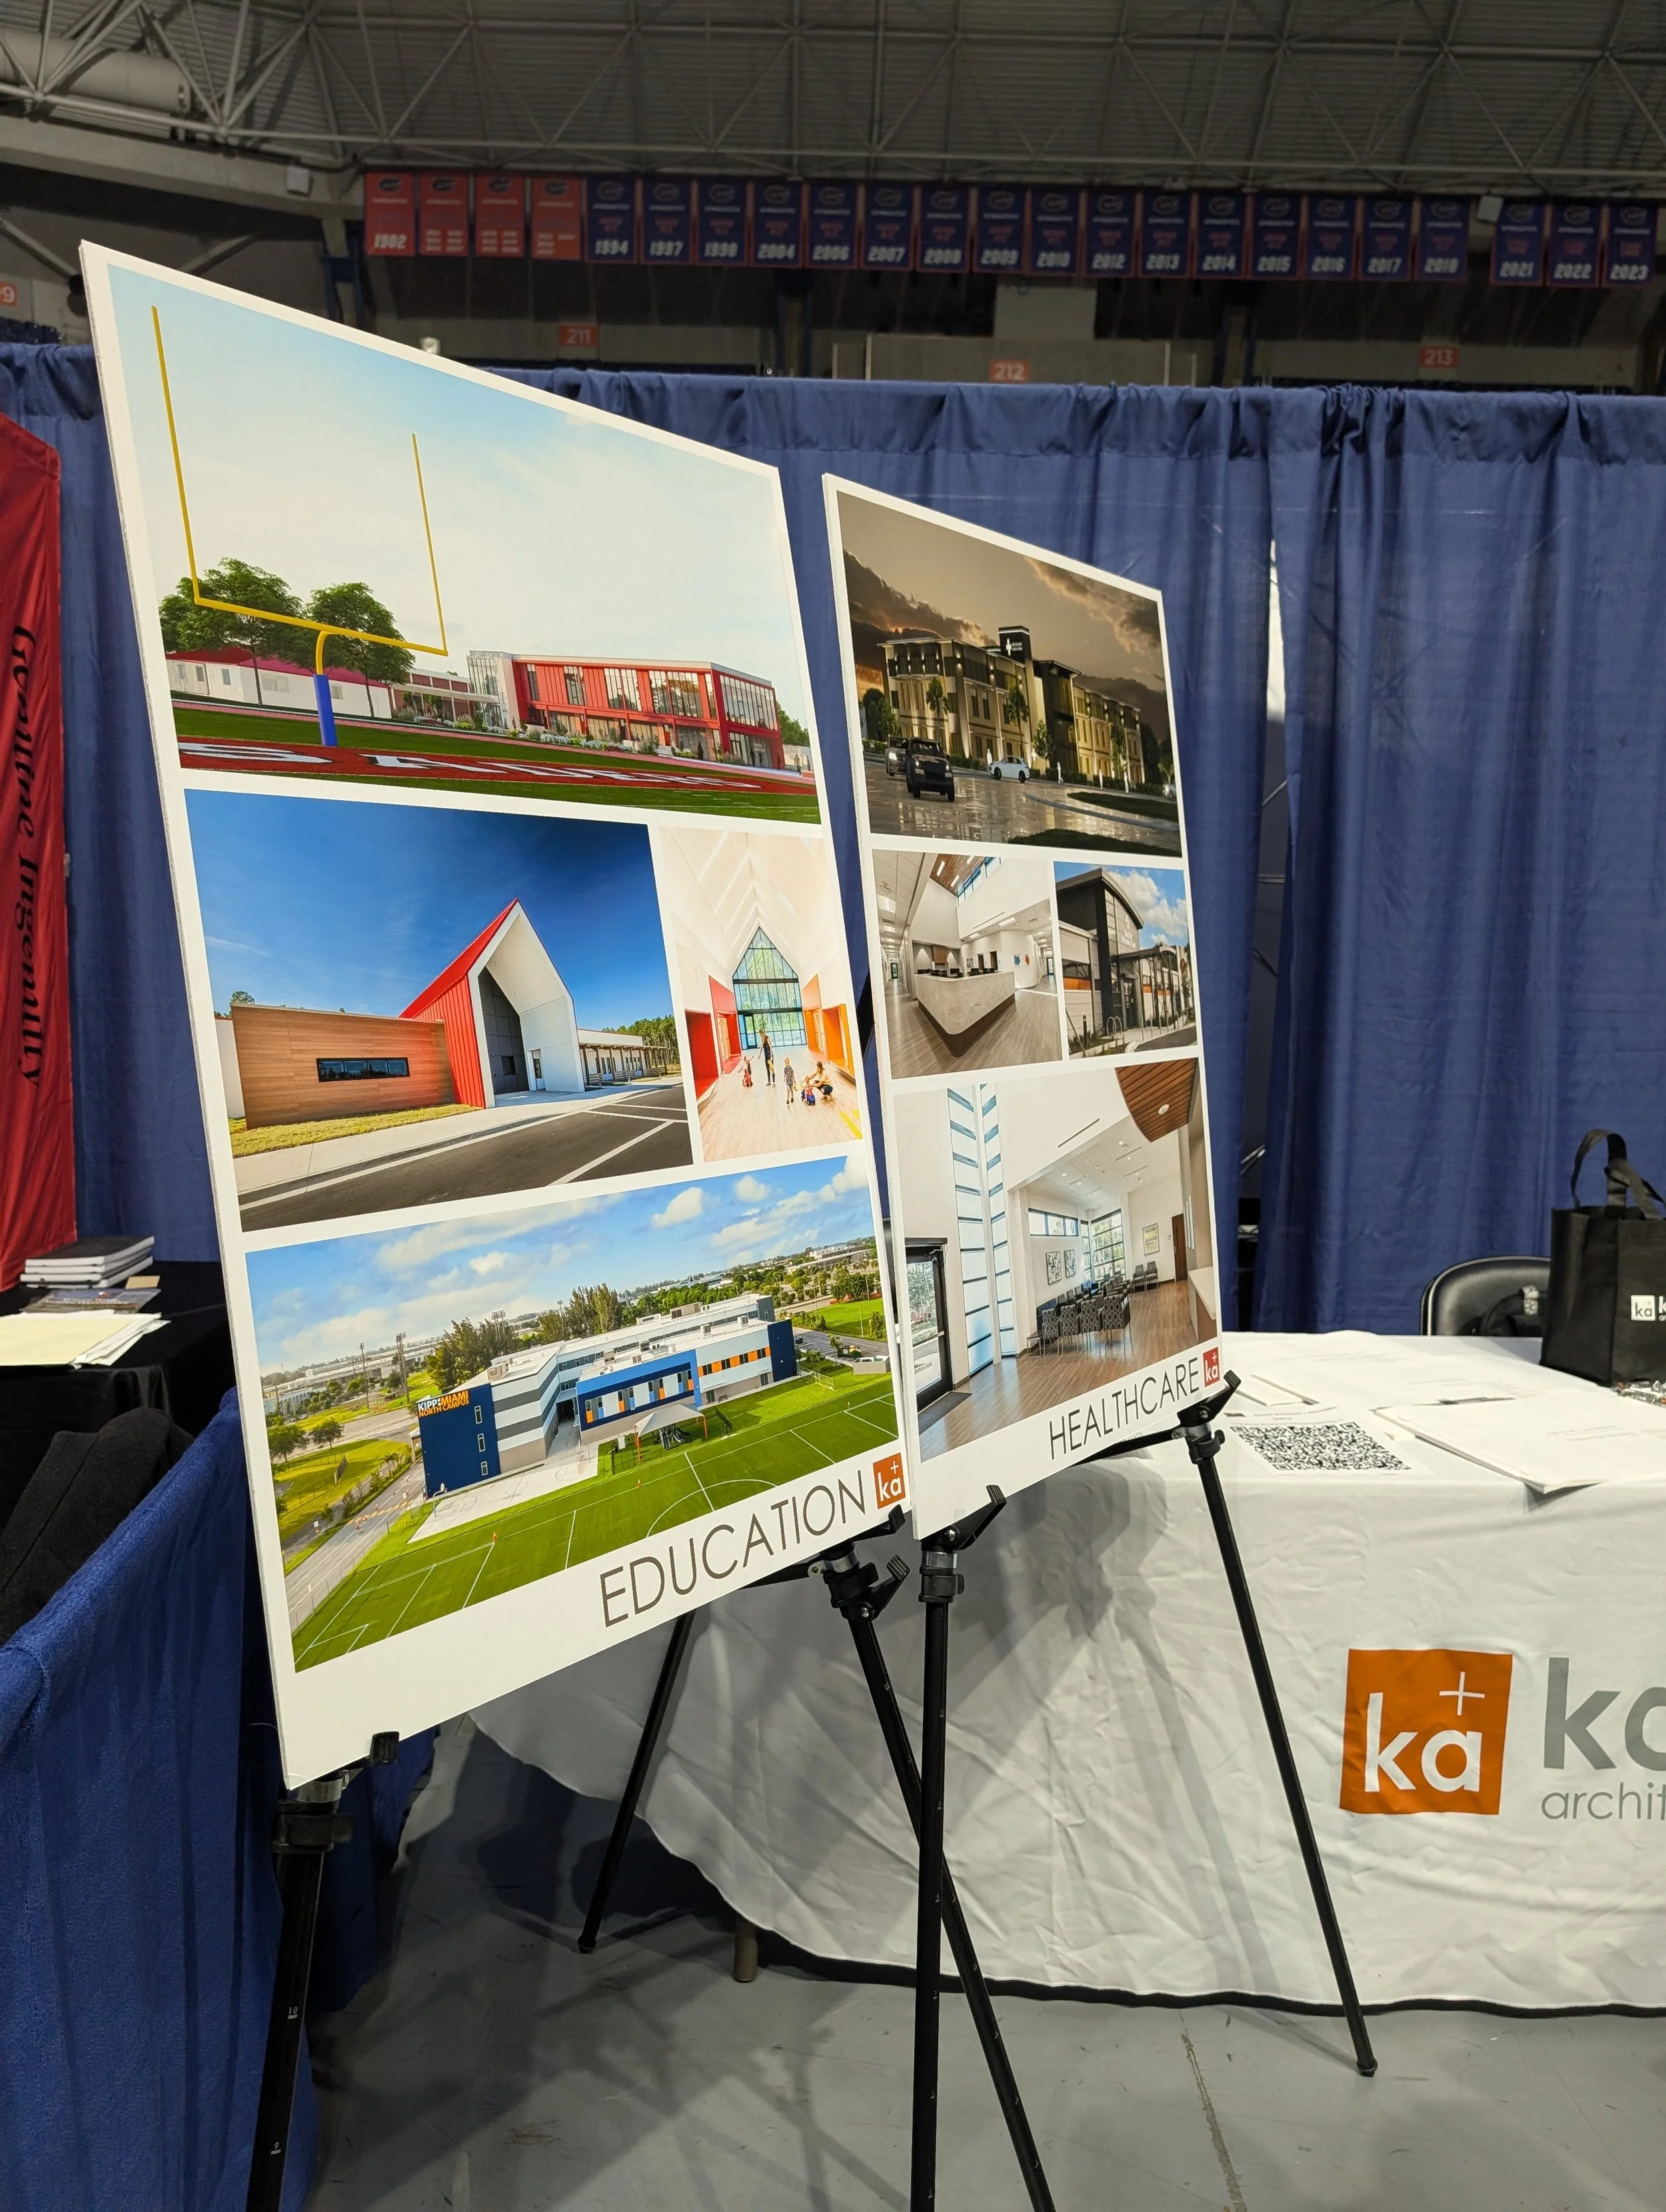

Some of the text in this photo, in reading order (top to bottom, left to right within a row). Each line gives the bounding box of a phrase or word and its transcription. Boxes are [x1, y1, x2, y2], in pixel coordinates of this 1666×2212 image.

[566, 328, 591, 344] 211
[1423, 348, 1453, 366] 213
[993, 362, 1024, 380] 212
[418, 1398, 470, 1418] NORTH CAMPUS
[1049, 1357, 1200, 1460] HEALTHCARE
[600, 1470, 866, 1627] EDUCATION
